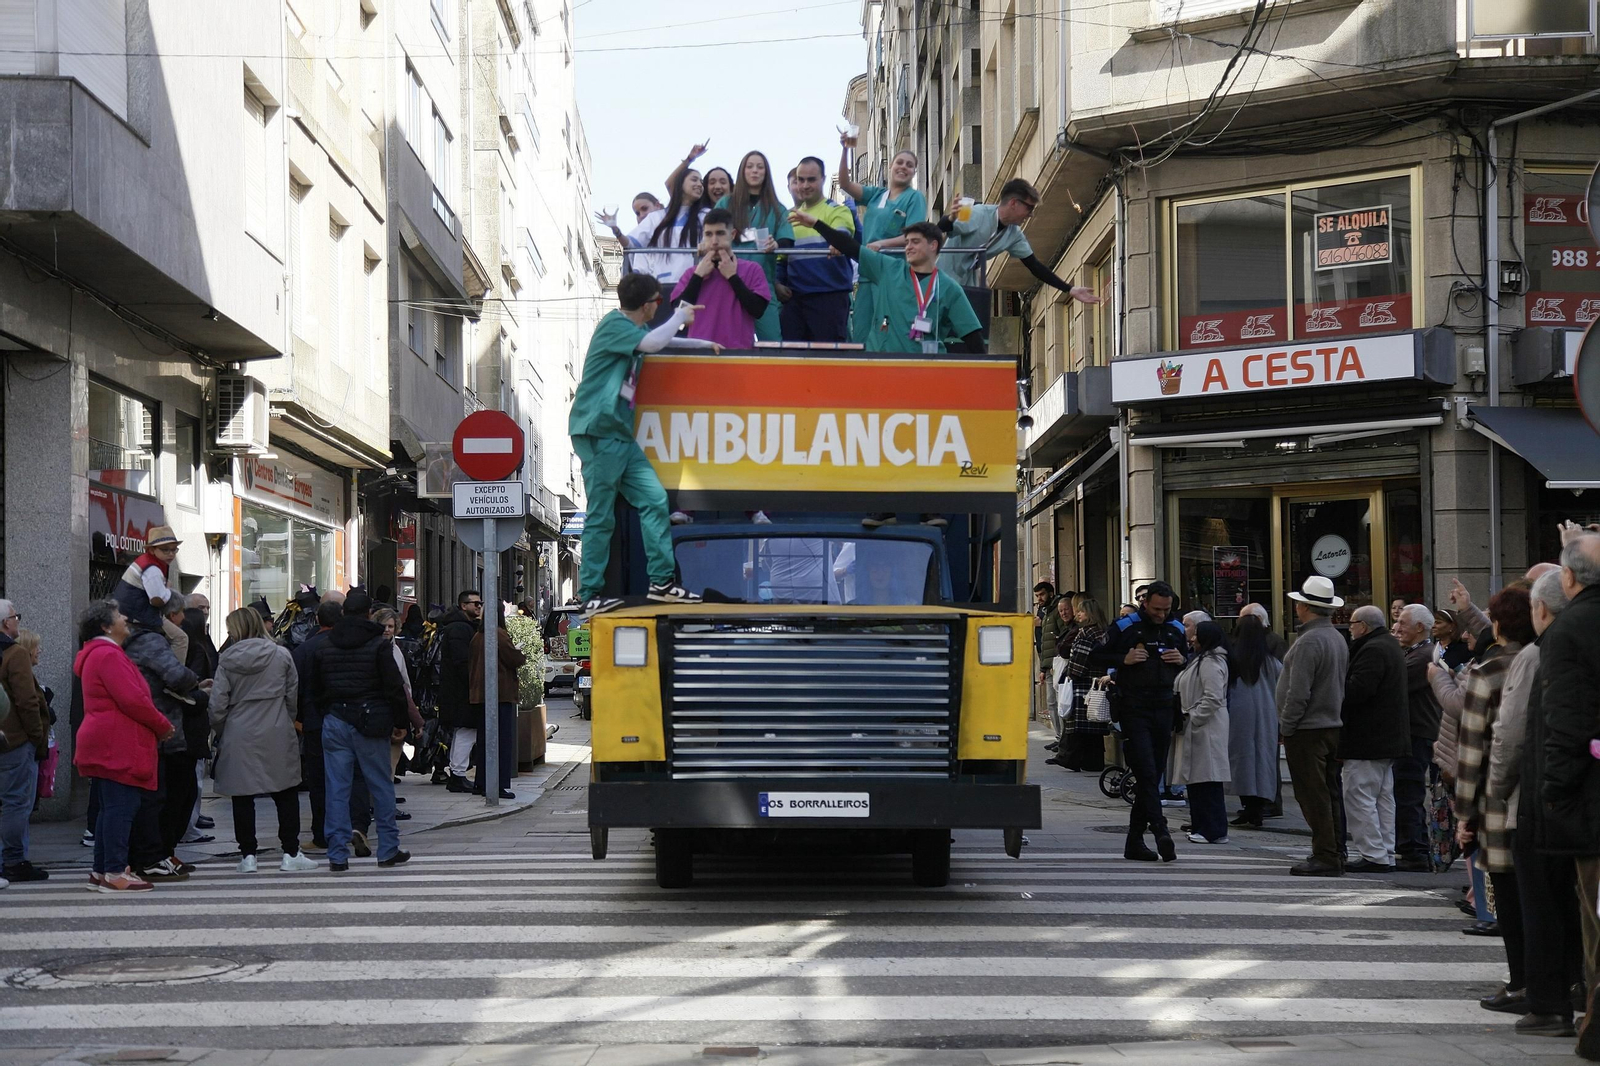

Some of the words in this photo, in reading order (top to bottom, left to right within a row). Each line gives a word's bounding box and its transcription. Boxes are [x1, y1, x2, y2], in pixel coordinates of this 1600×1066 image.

[1319, 217, 1334, 233] SE
[1337, 210, 1388, 231] ALQUILA
[1320, 243, 1388, 264] 616046083
[1552, 250, 1588, 267] 988
[1202, 358, 1229, 392] A
[1242, 346, 1366, 388] CESTA
[635, 411, 972, 467] AMBULANCIA
[474, 485, 506, 494] EXCEPTO
[470, 495, 509, 504] VEHÍCULOS
[466, 506, 515, 515] AUTORIZADOS
[120, 536, 146, 553] COTTON
[1314, 549, 1348, 561] Latorta
[768, 800, 784, 808] OS
[789, 800, 868, 808] BORRALLEIROS
